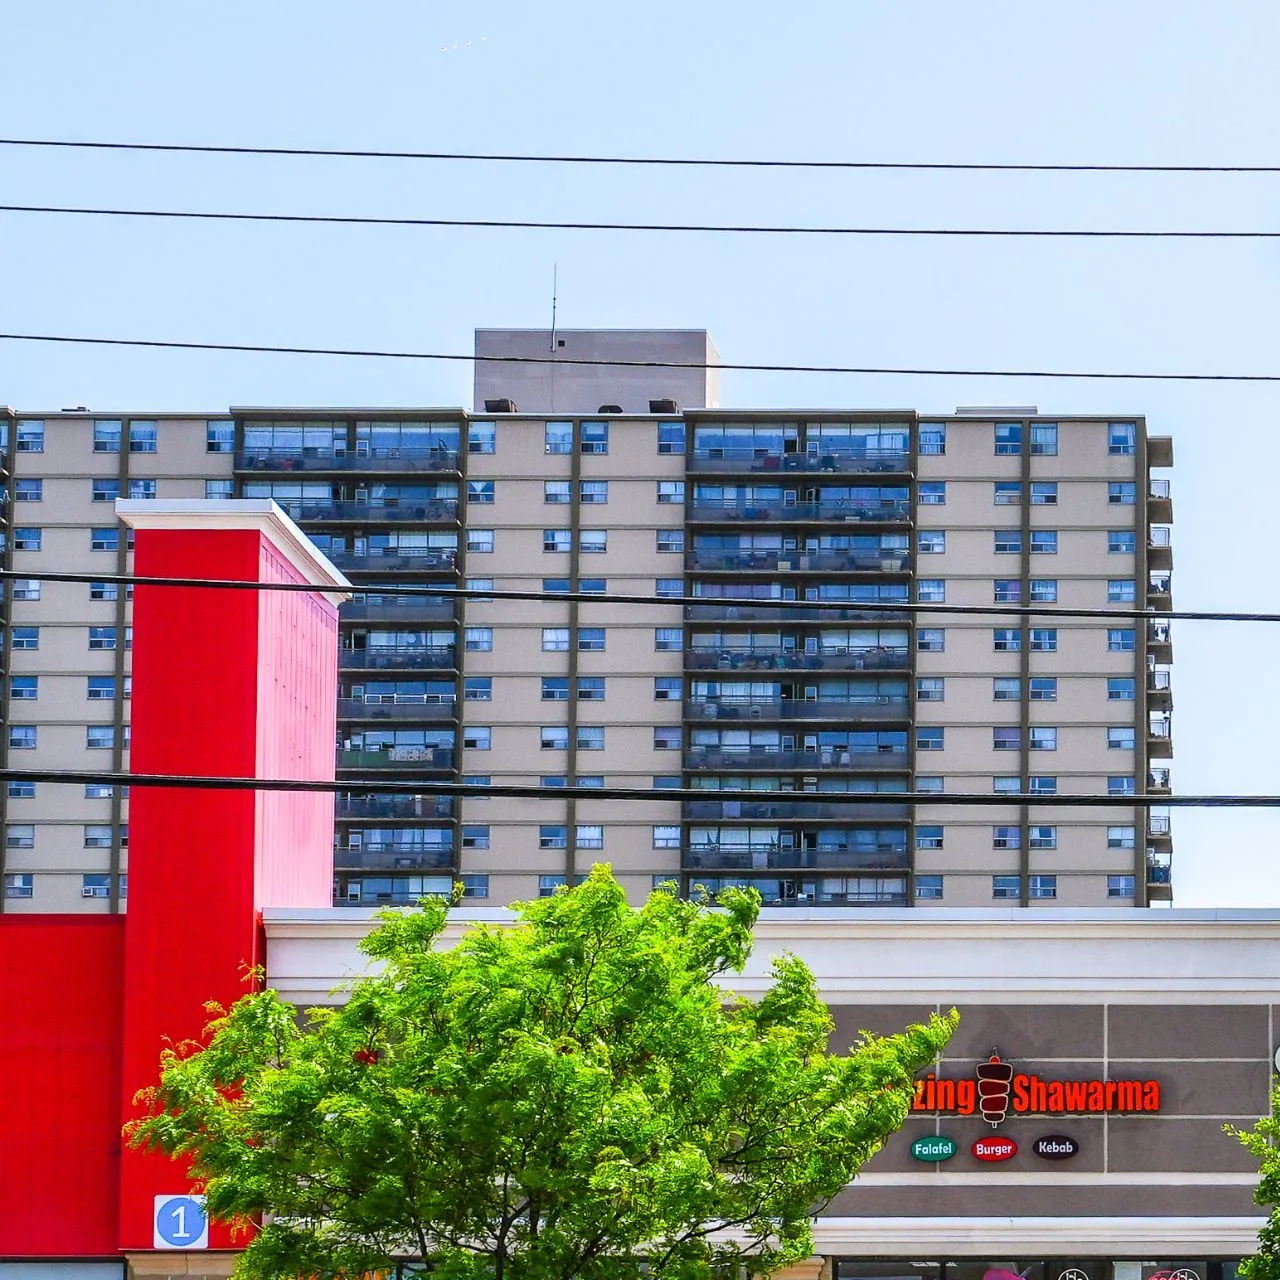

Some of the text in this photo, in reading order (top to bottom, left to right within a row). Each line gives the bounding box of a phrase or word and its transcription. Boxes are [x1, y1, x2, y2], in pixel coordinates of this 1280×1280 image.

[911, 1073, 1160, 1115] zing Shawarma
[915, 1142, 952, 1155] Falafel
[976, 1143, 1012, 1158] Burger
[1038, 1141, 1074, 1154] Kebab
[171, 1206, 191, 1238] 1
